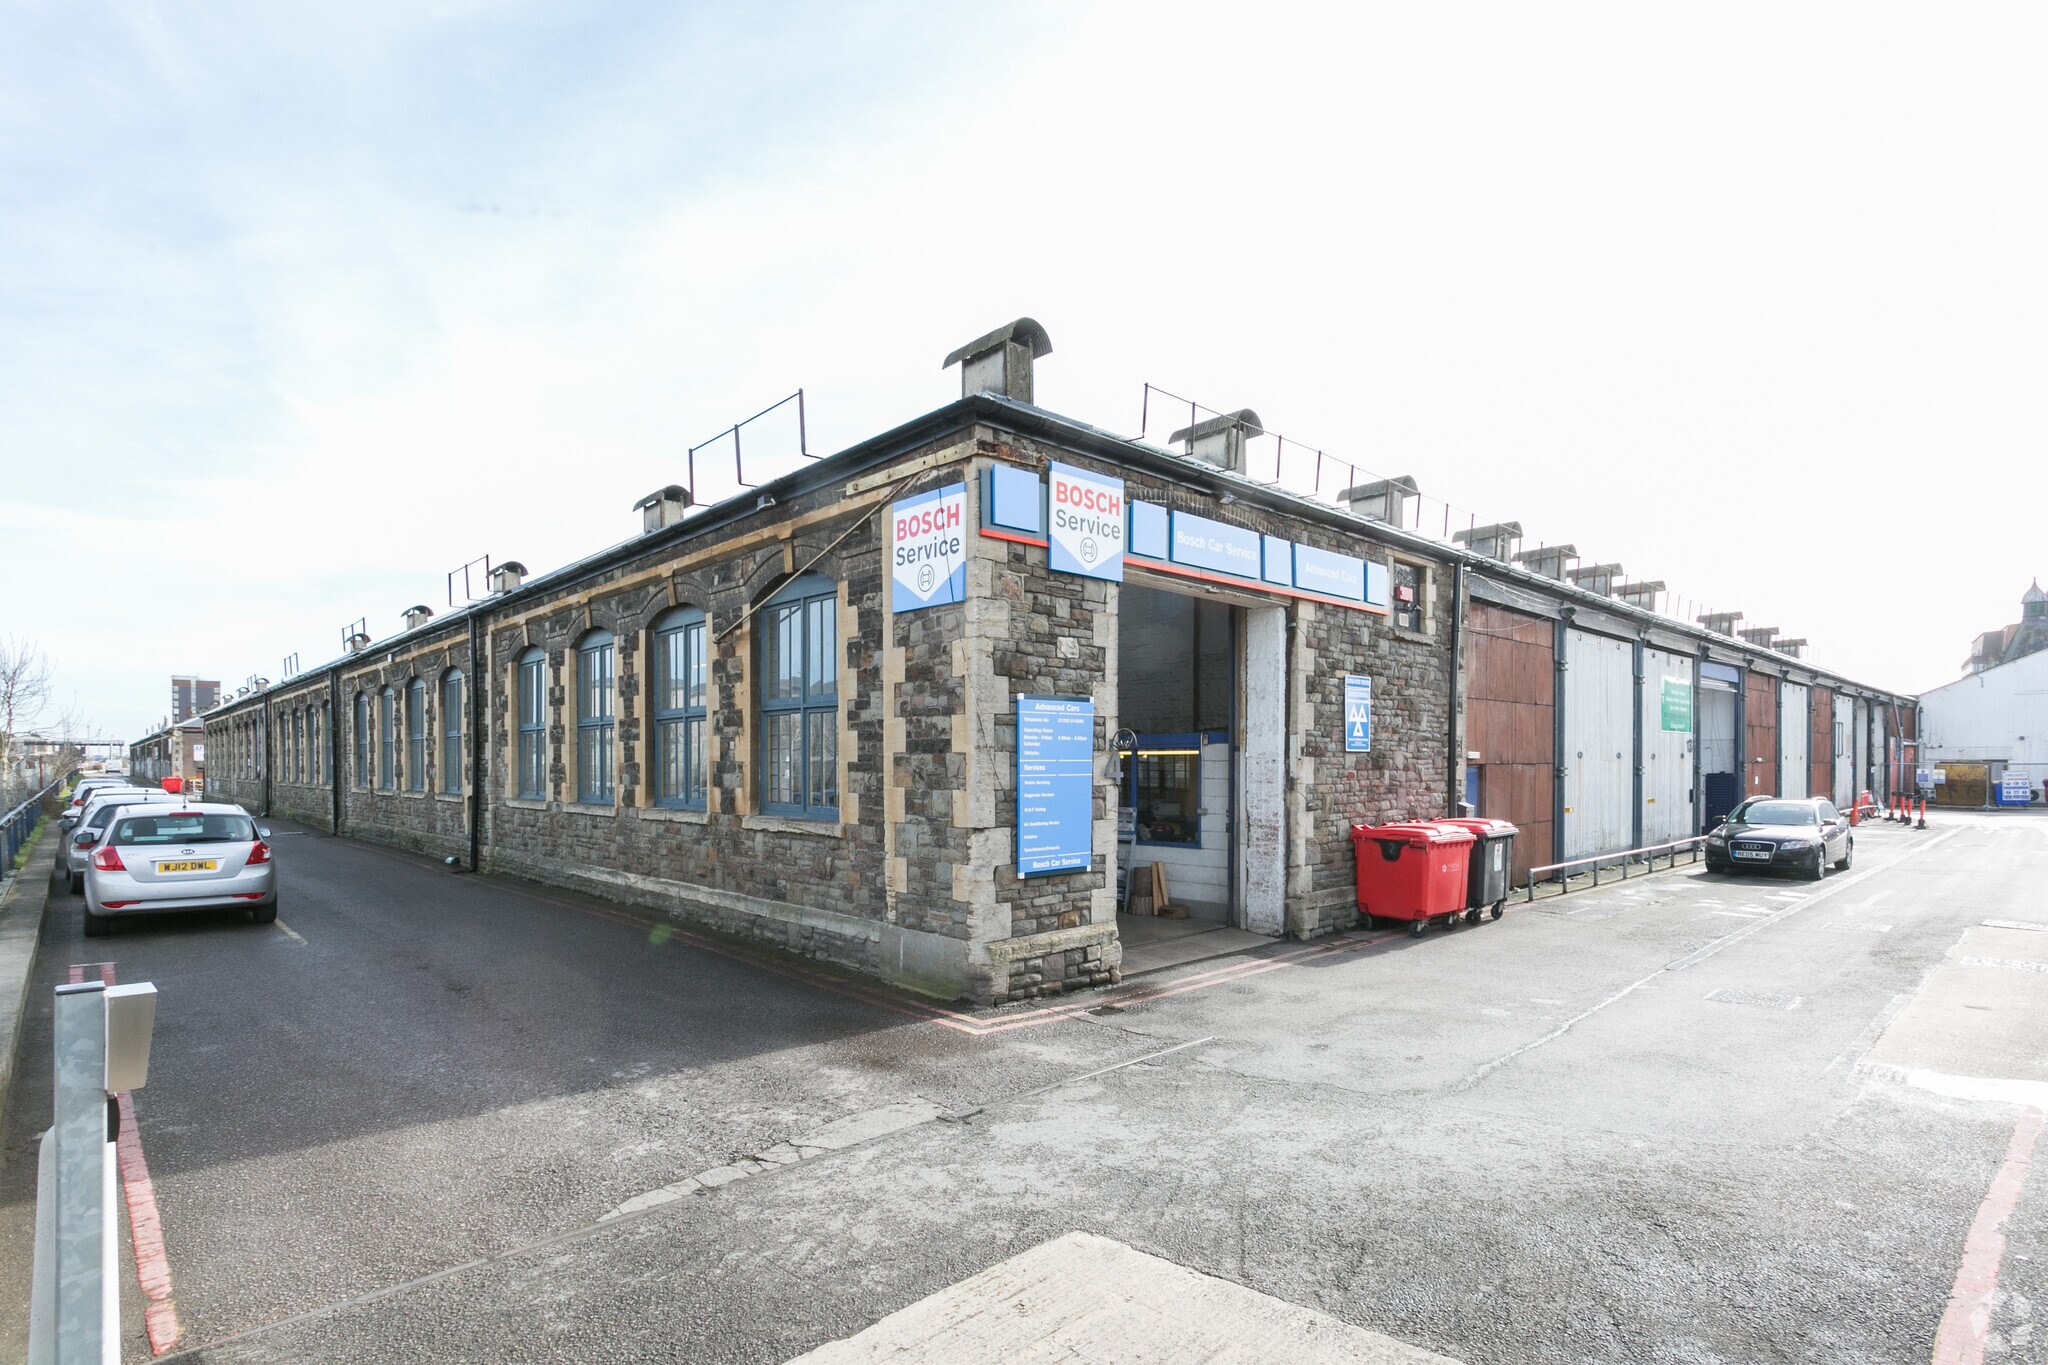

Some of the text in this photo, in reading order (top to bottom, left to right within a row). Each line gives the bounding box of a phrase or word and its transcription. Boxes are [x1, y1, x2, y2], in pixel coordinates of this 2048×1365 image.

[1056, 481, 1120, 517] BOSCH
[896, 503, 960, 542] BOSCH
[1056, 508, 1120, 540] Service
[896, 536, 960, 567] Service
[1177, 530, 1257, 561] Bosch Car Service
[1305, 562, 1357, 584] Advanced Cars
[1035, 703, 1080, 712] Advanced Cars
[1104, 751, 1124, 784] 4
[164, 860, 211, 871] WJ12 DWL
[1033, 857, 1081, 869] Bosch Car Service
